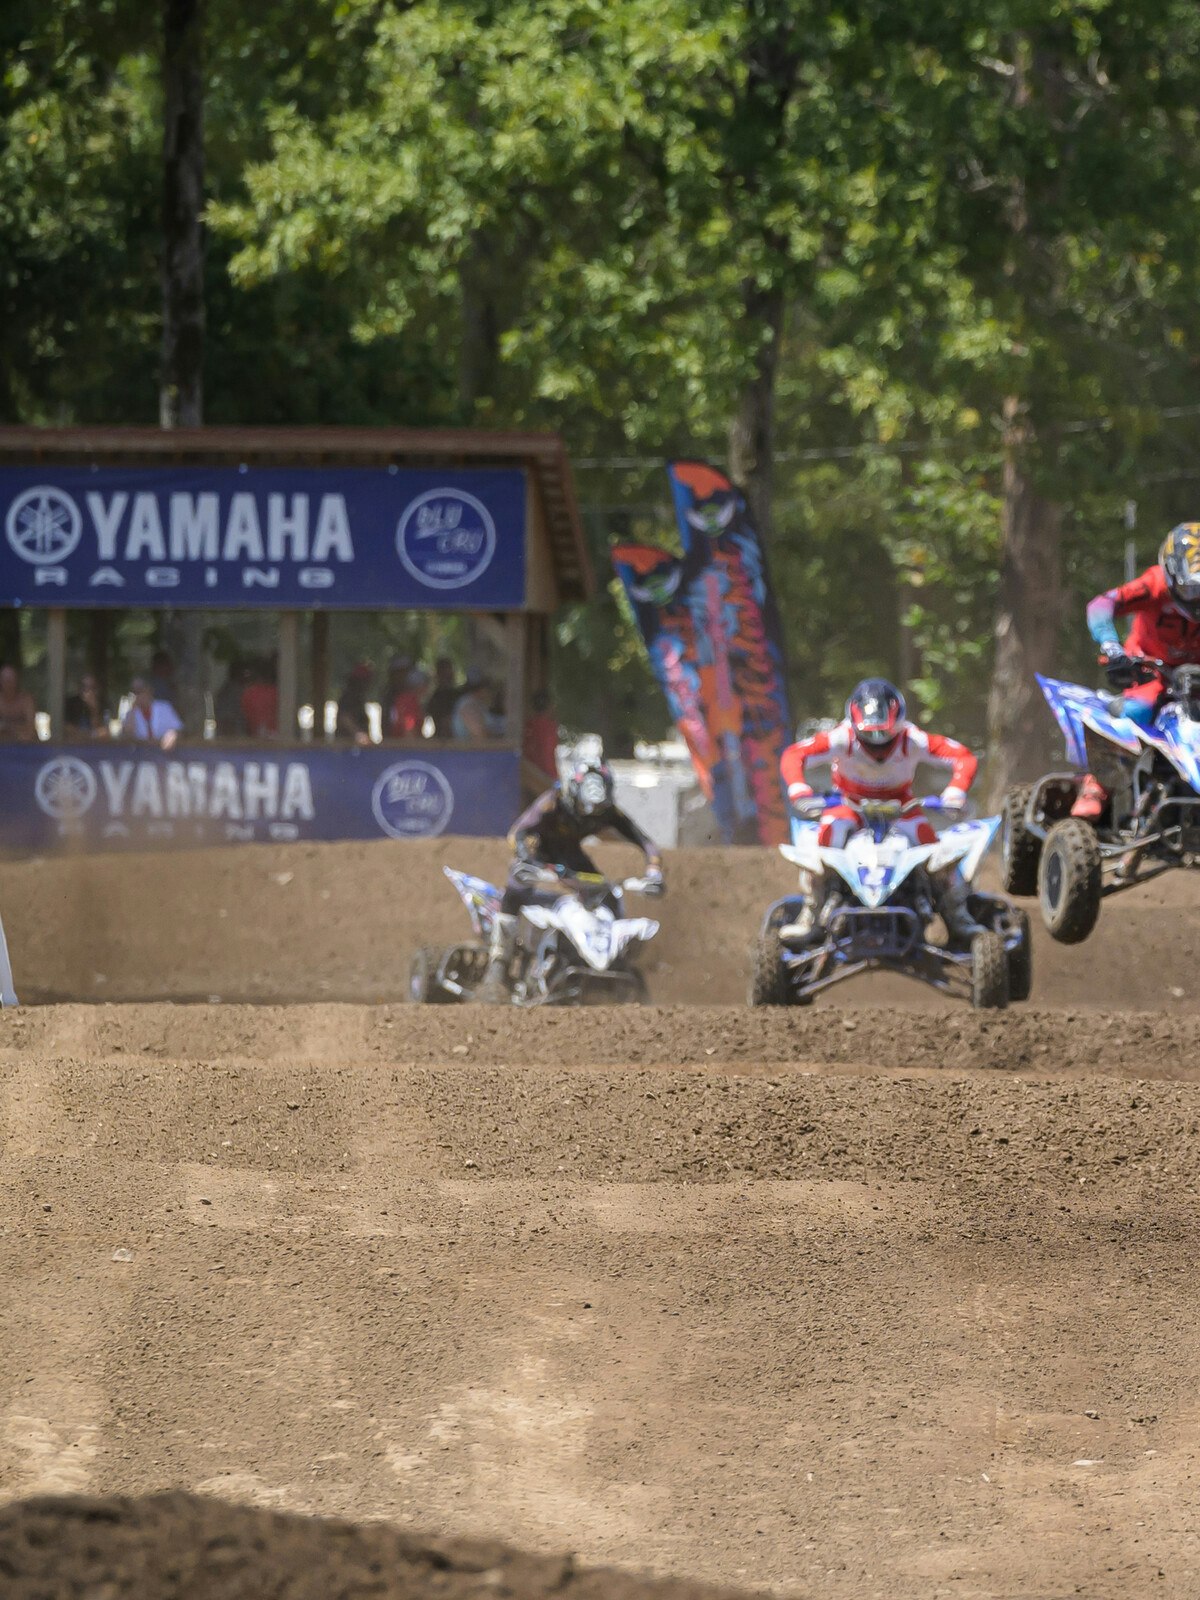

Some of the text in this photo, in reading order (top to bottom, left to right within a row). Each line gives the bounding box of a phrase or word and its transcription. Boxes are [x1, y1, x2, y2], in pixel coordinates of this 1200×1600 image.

[86, 491, 354, 562] YAMAHA
[34, 566, 336, 588] RACING
[101, 761, 316, 820] YAMAHA
